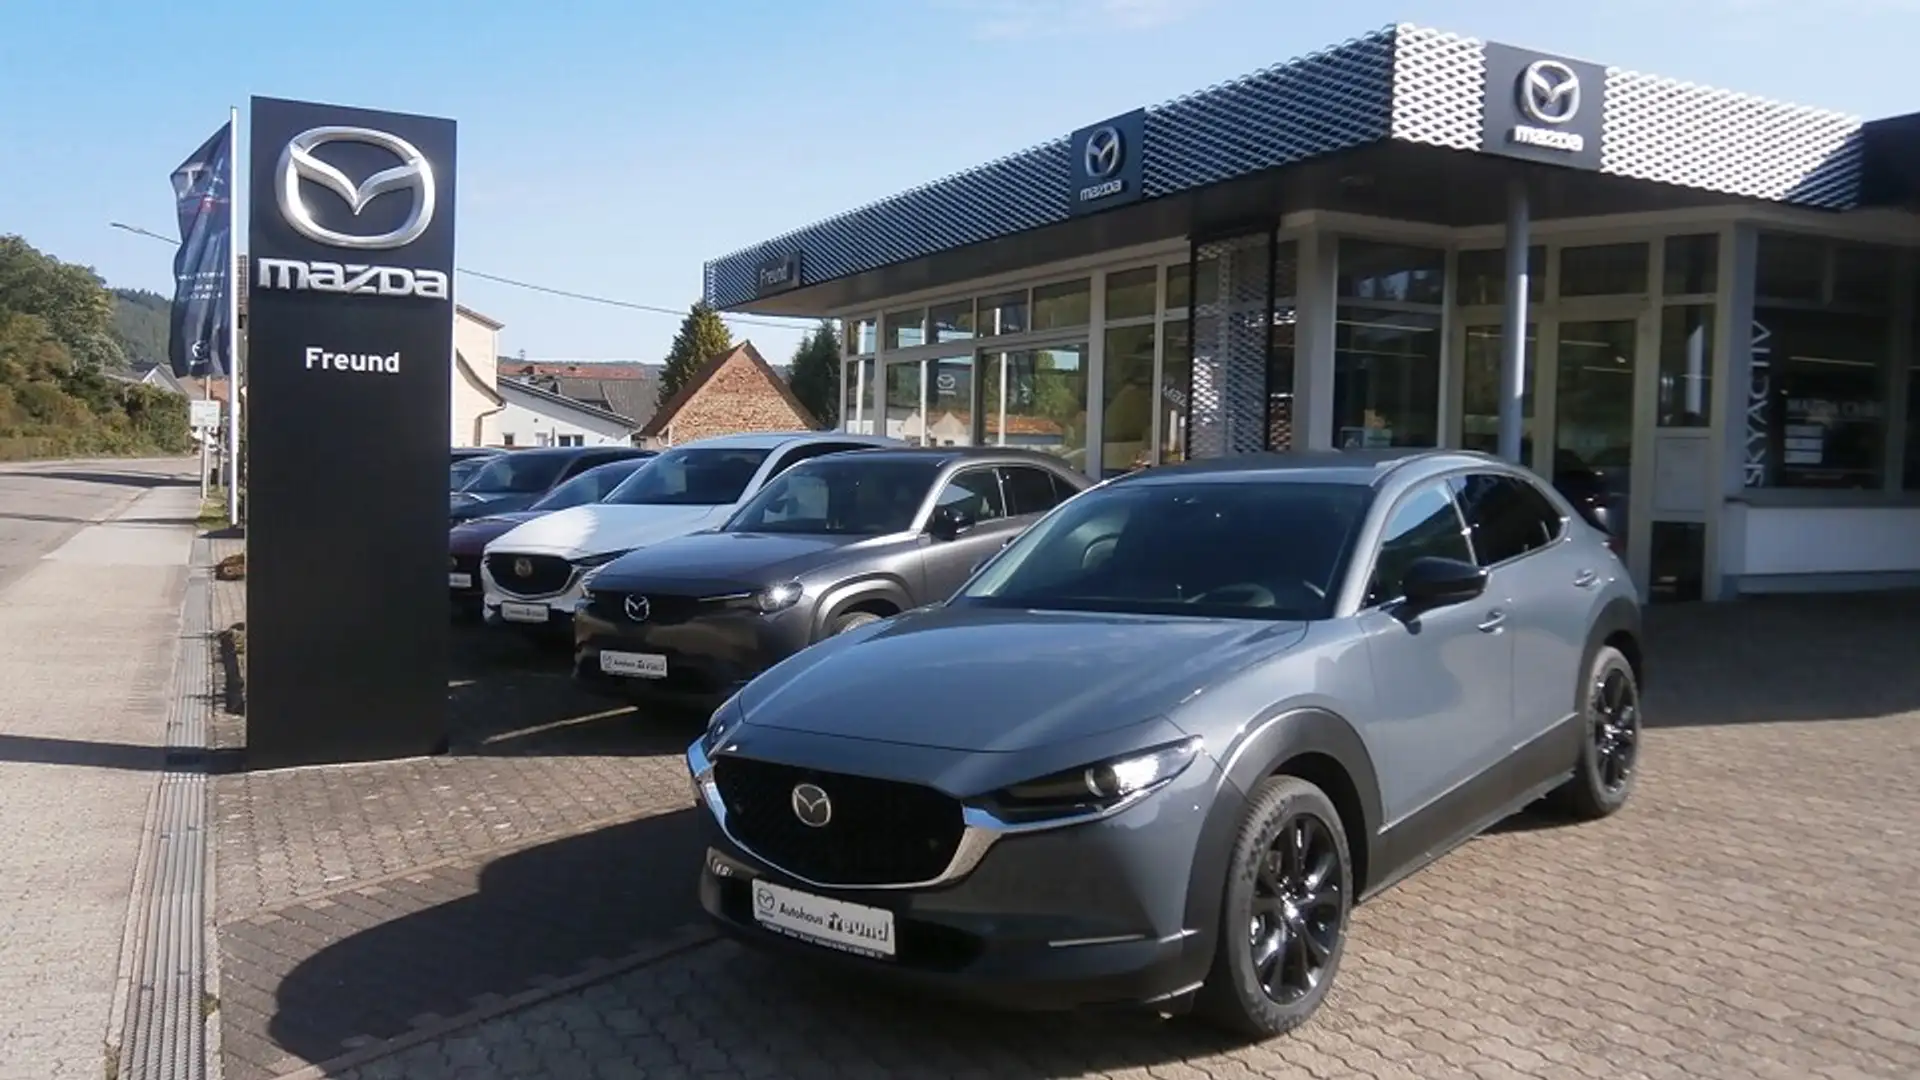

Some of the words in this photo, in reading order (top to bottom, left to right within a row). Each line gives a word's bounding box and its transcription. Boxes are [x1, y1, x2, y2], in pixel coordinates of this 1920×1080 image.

[305, 347, 400, 373] Freund
[1743, 320, 1772, 488] SKYACTIV
[779, 902, 824, 925] Autohaus
